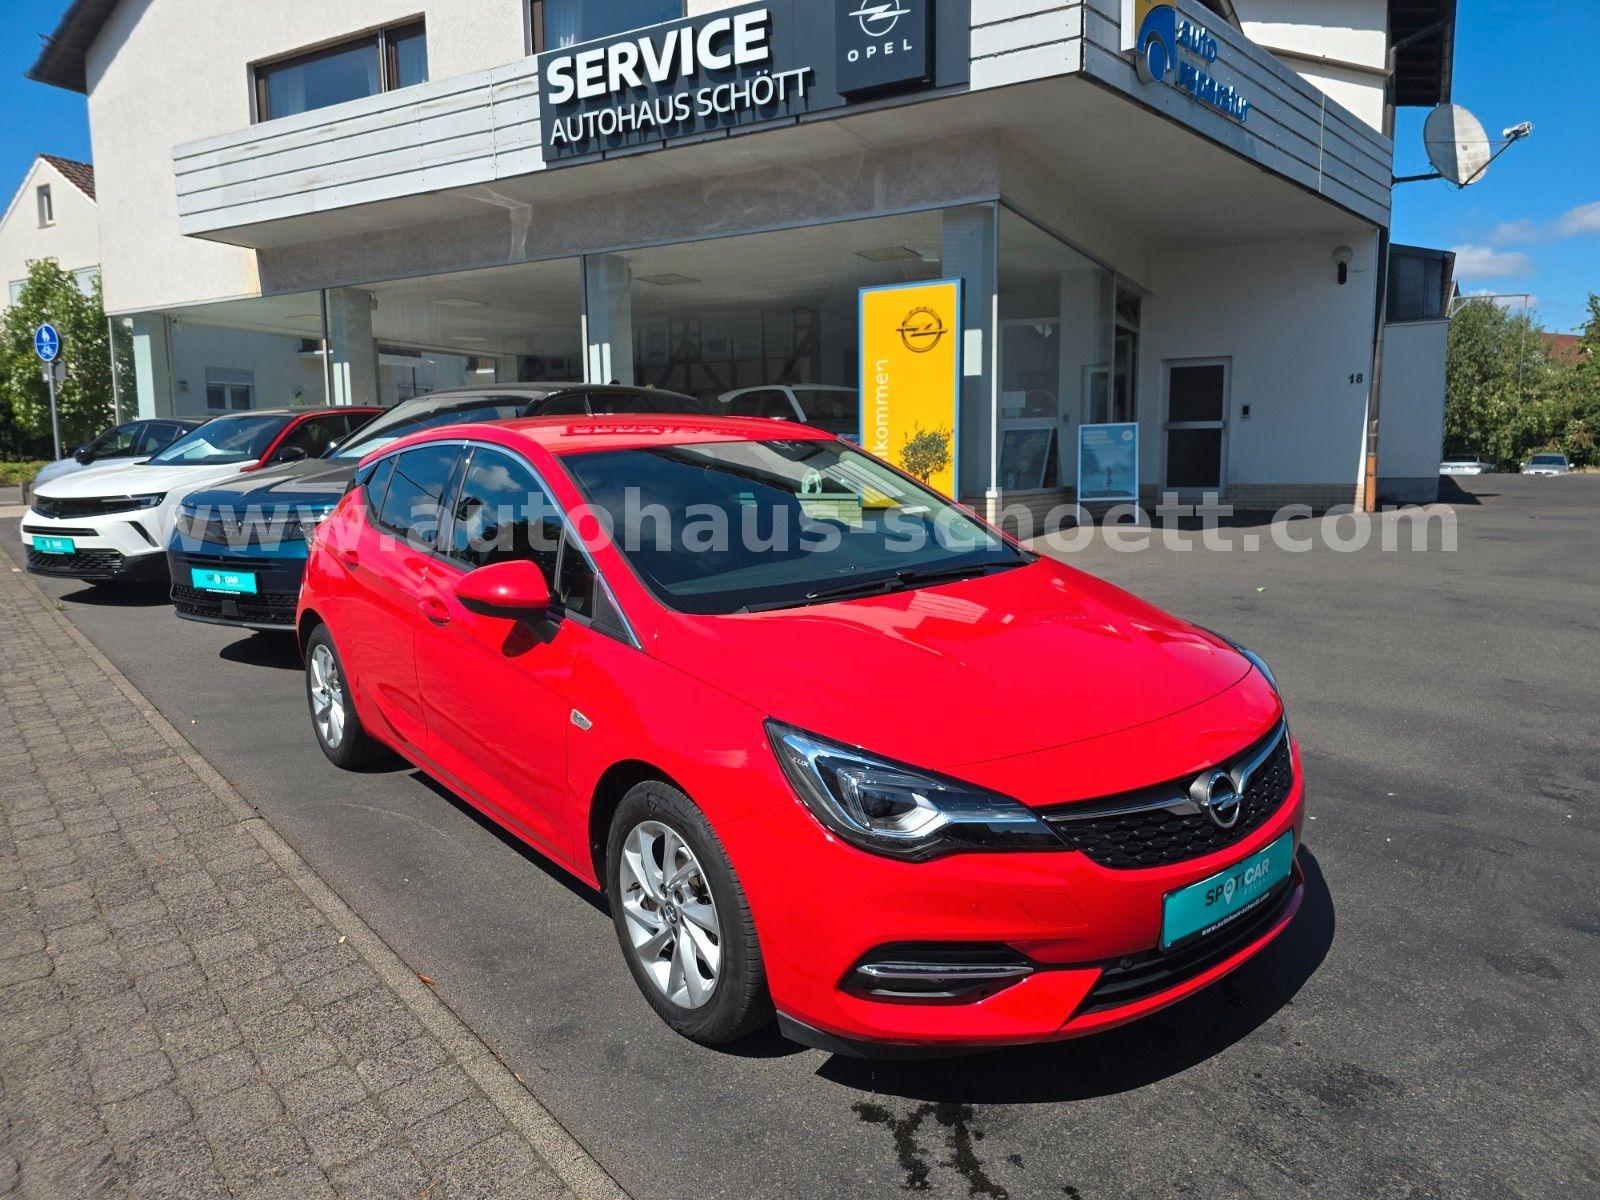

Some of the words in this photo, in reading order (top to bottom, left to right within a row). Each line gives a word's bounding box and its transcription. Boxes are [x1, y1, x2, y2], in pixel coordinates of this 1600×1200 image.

[546, 8, 770, 105] SERVICE
[847, 39, 913, 63] OPEL
[1177, 20, 1218, 64] auto
[550, 92, 690, 146] AUTOHAUS
[697, 66, 812, 118] SCHÖTT
[872, 359, 889, 461] lkommen
[1348, 373, 1363, 385] 18
